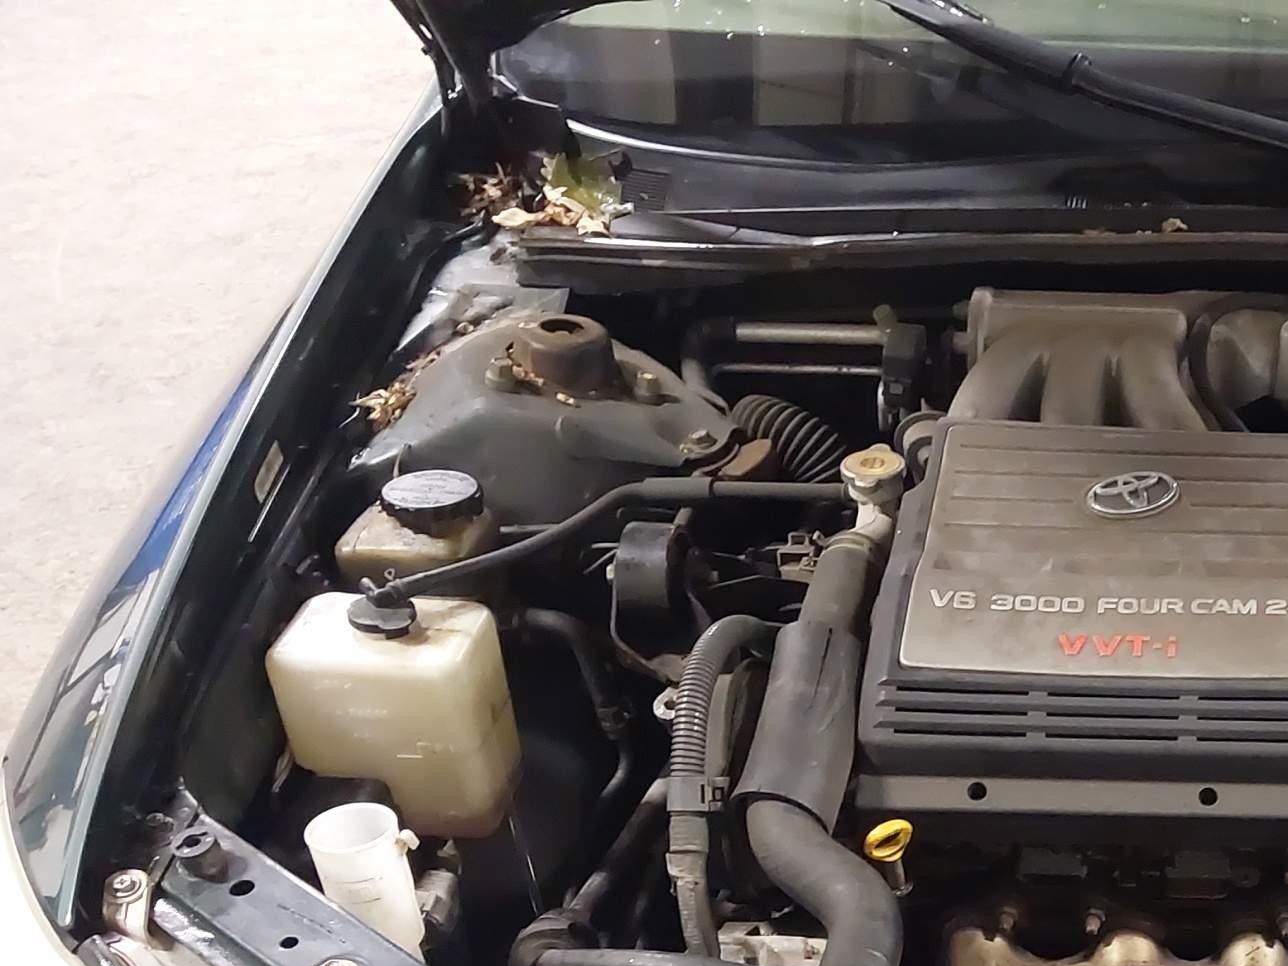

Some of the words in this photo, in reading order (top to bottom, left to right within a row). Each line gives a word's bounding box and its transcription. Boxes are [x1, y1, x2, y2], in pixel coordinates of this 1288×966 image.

[930, 589, 977, 610] V6
[990, 594, 1085, 614] 3000
[1097, 597, 1185, 615] FOUR
[1191, 598, 1258, 616] CAM
[1057, 632, 1178, 658] VVT-i
